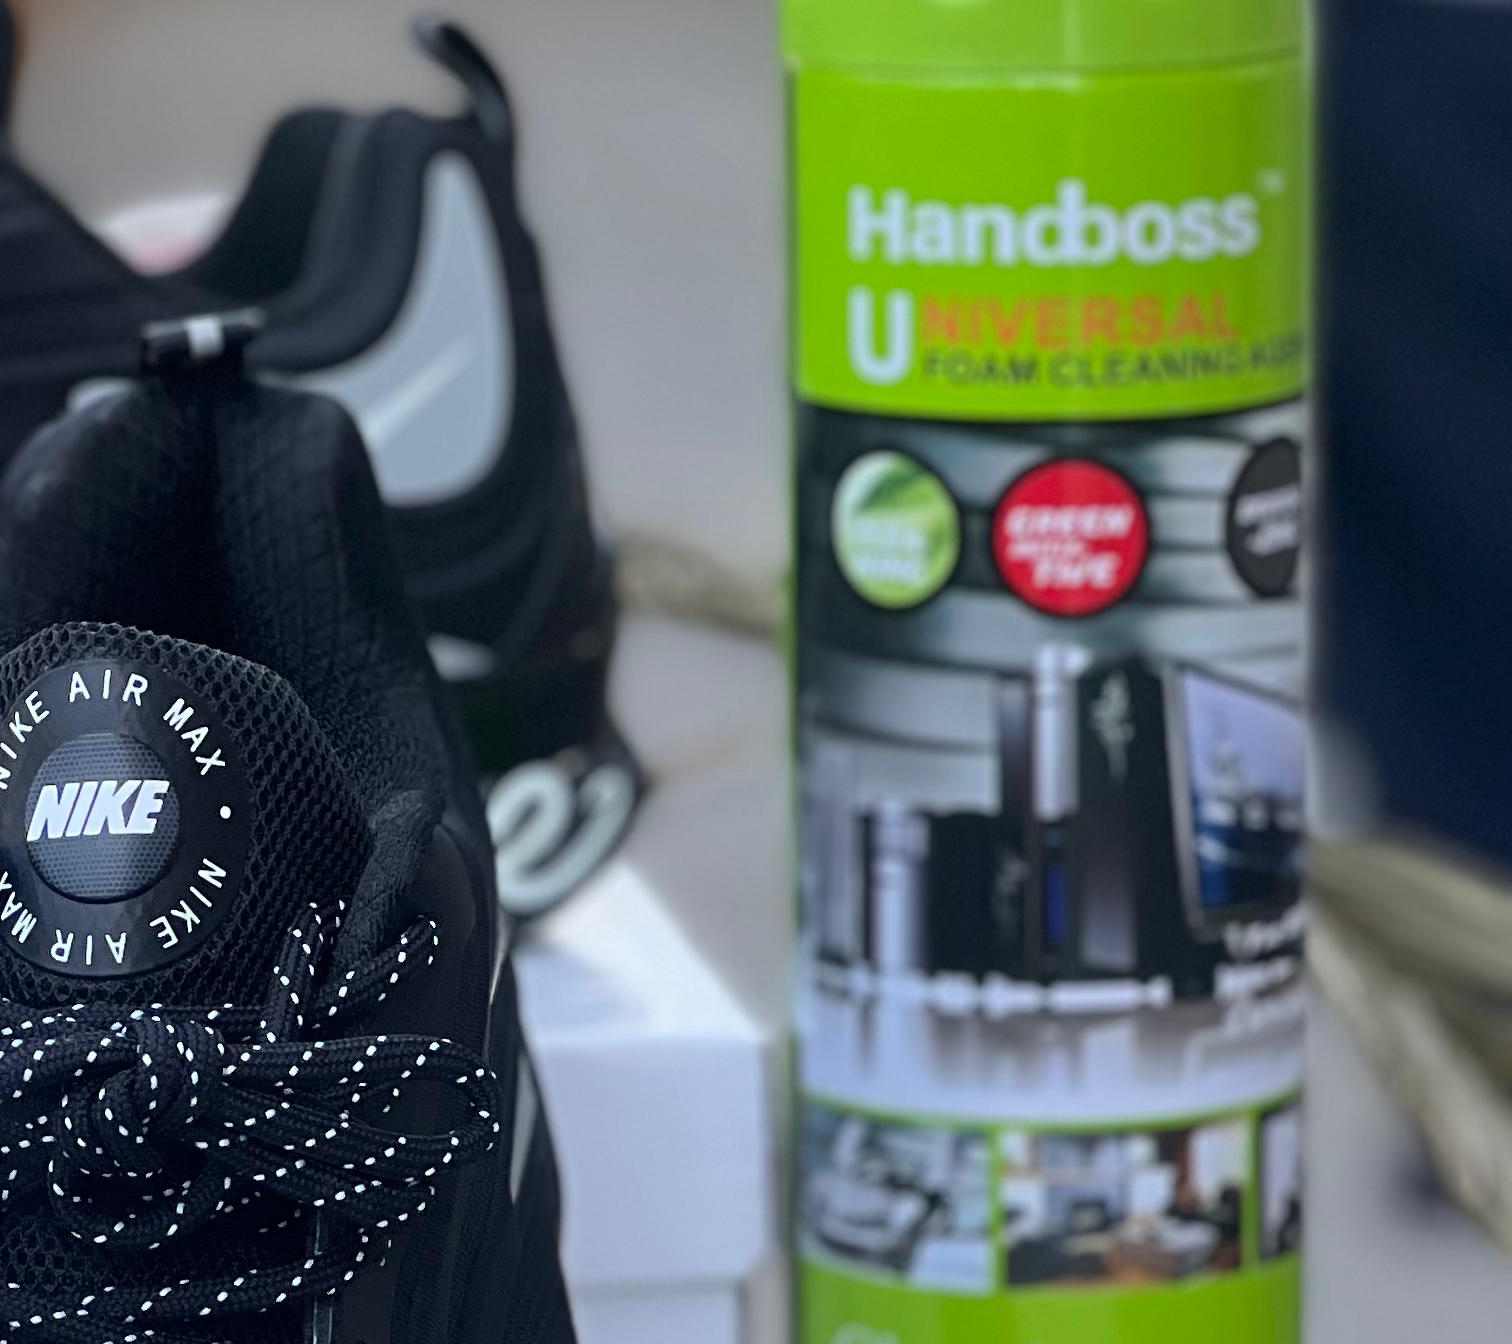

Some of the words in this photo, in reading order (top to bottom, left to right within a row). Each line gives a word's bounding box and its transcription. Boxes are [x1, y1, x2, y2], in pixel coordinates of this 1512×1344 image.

[848, 178, 1260, 267] Handboss
[924, 352, 1040, 388] FOAM
[69, 669, 148, 707] AIR
[163, 698, 226, 776] MAX
[26, 779, 170, 842] NIKE
[149, 858, 227, 949] NIKE
[50, 930, 127, 966] AIR
